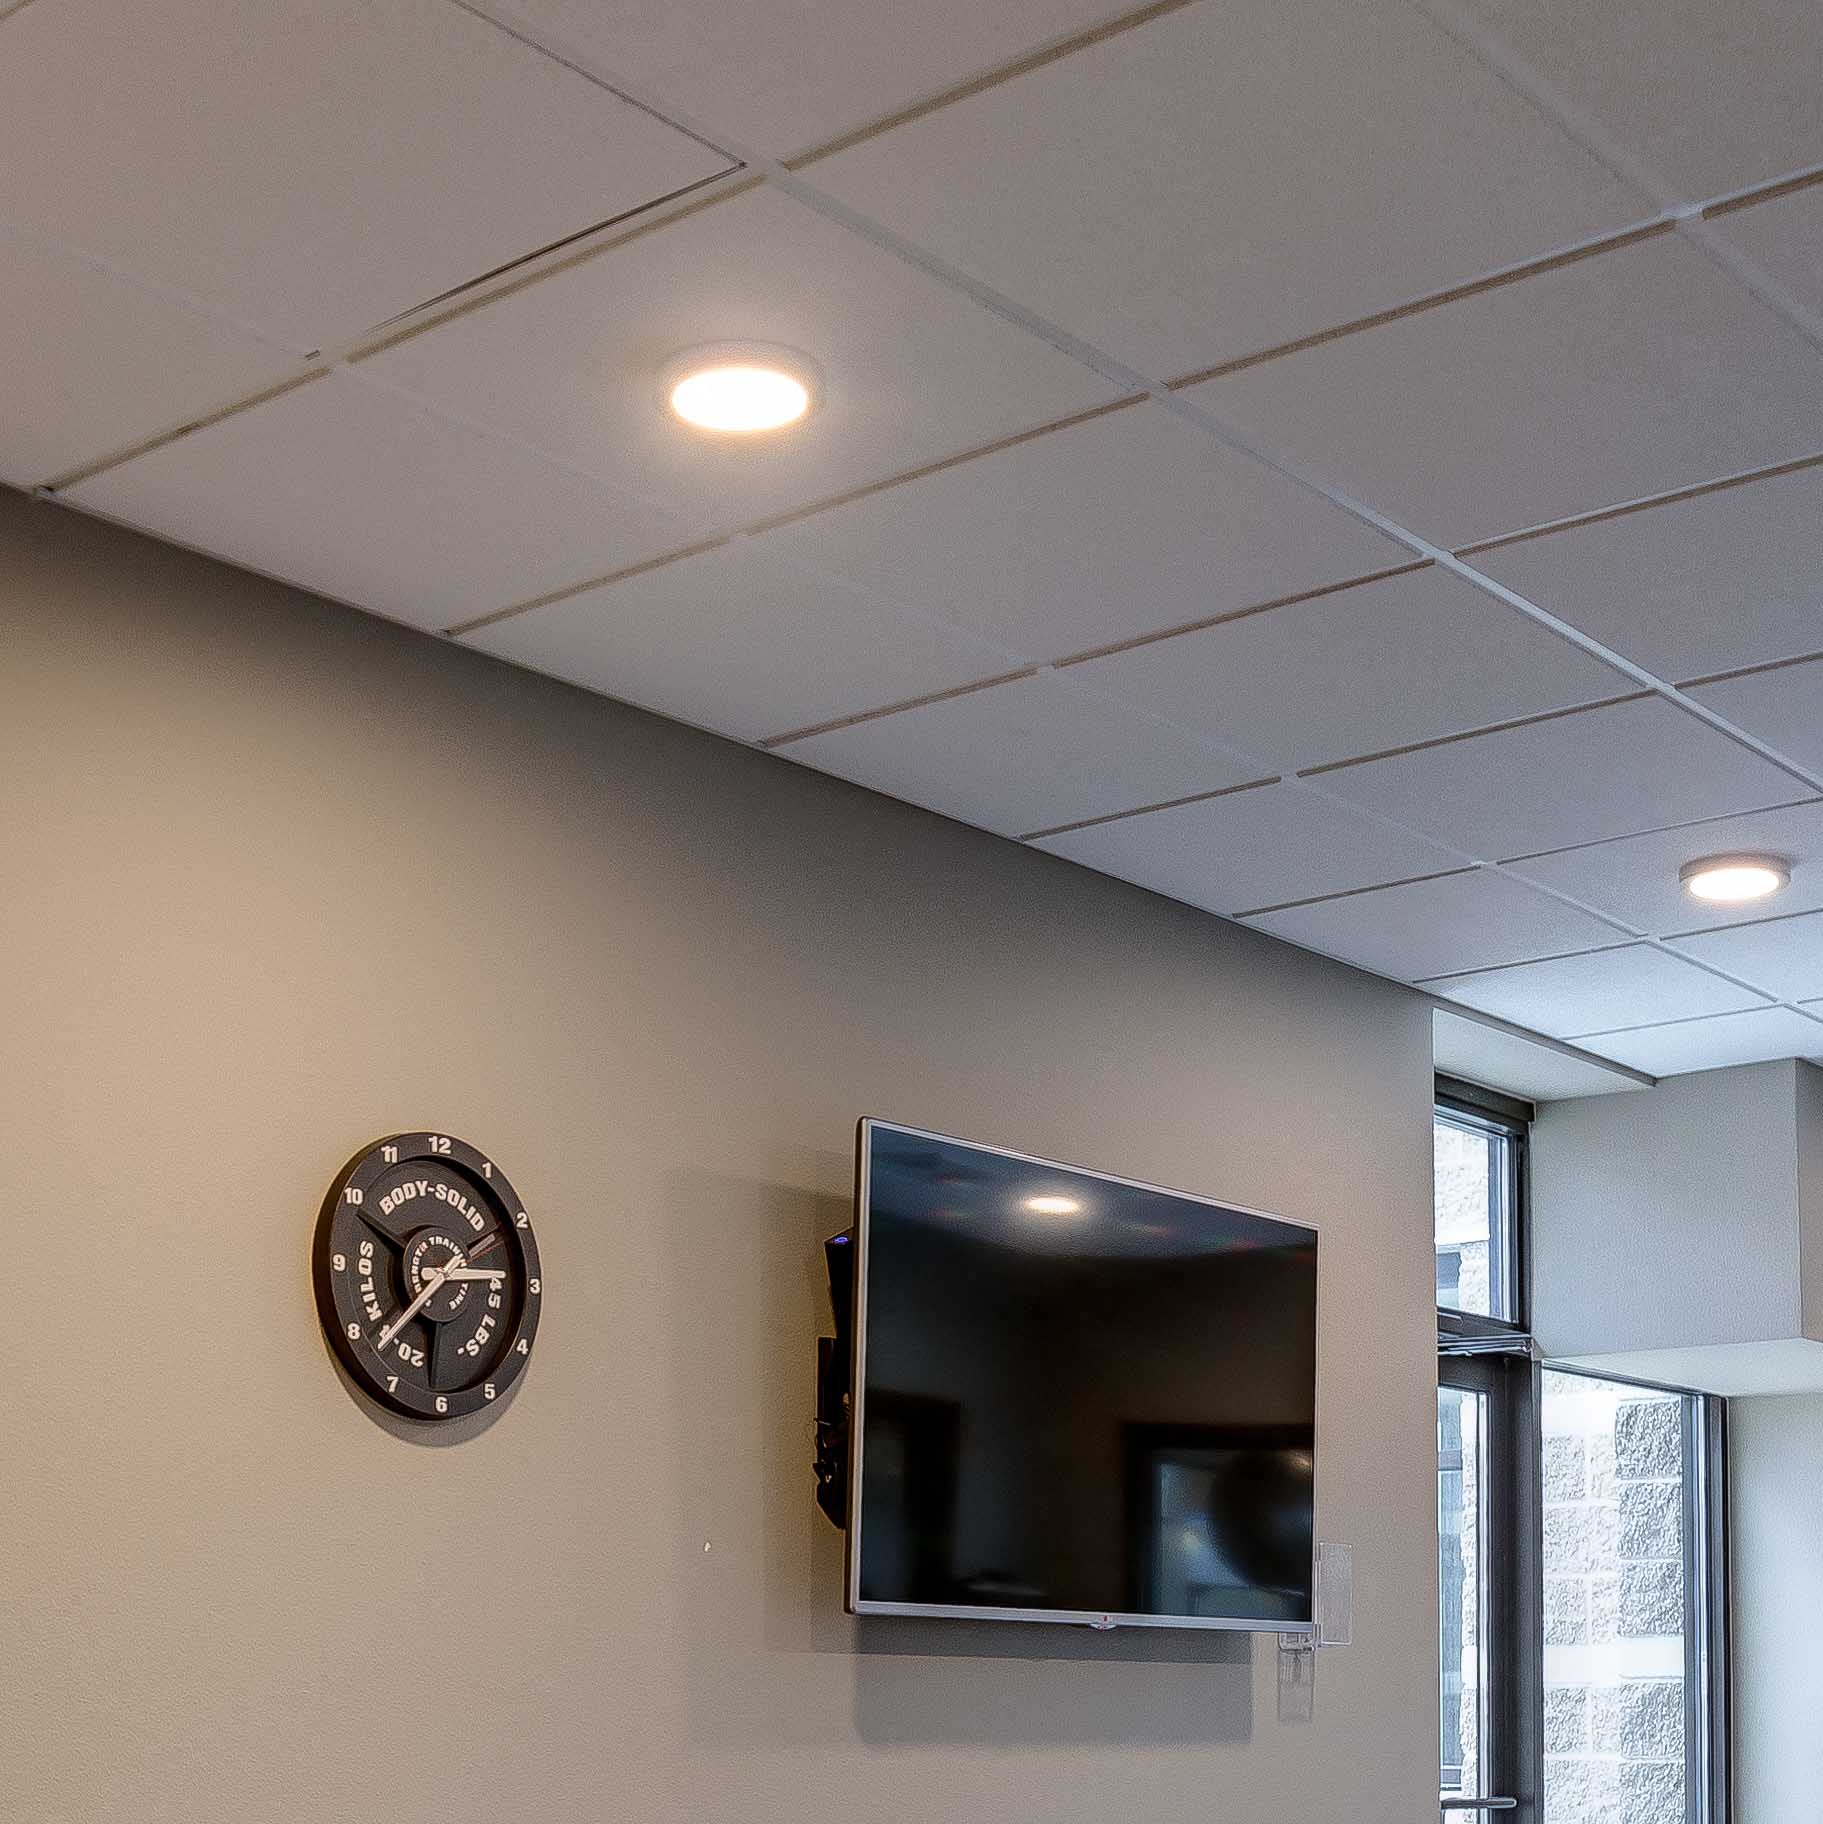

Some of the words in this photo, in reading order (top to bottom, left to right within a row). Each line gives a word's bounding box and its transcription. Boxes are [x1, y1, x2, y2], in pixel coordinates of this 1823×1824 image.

[381, 1145, 398, 1163] 11
[428, 1136, 452, 1155] 12
[482, 1162, 492, 1178] 1
[344, 1187, 364, 1205] 10
[379, 1180, 485, 1232] BODY-SOLID
[516, 1211, 528, 1228] 2
[332, 1254, 346, 1272] 9
[358, 1241, 382, 1321] KILOS
[529, 1278, 541, 1294] 3
[488, 1277, 502, 1309] 45
[347, 1322, 361, 1340] 8
[516, 1338, 528, 1355] 4
[386, 1375, 399, 1393] 7
[484, 1383, 498, 1401] 5
[435, 1396, 448, 1413] 6
